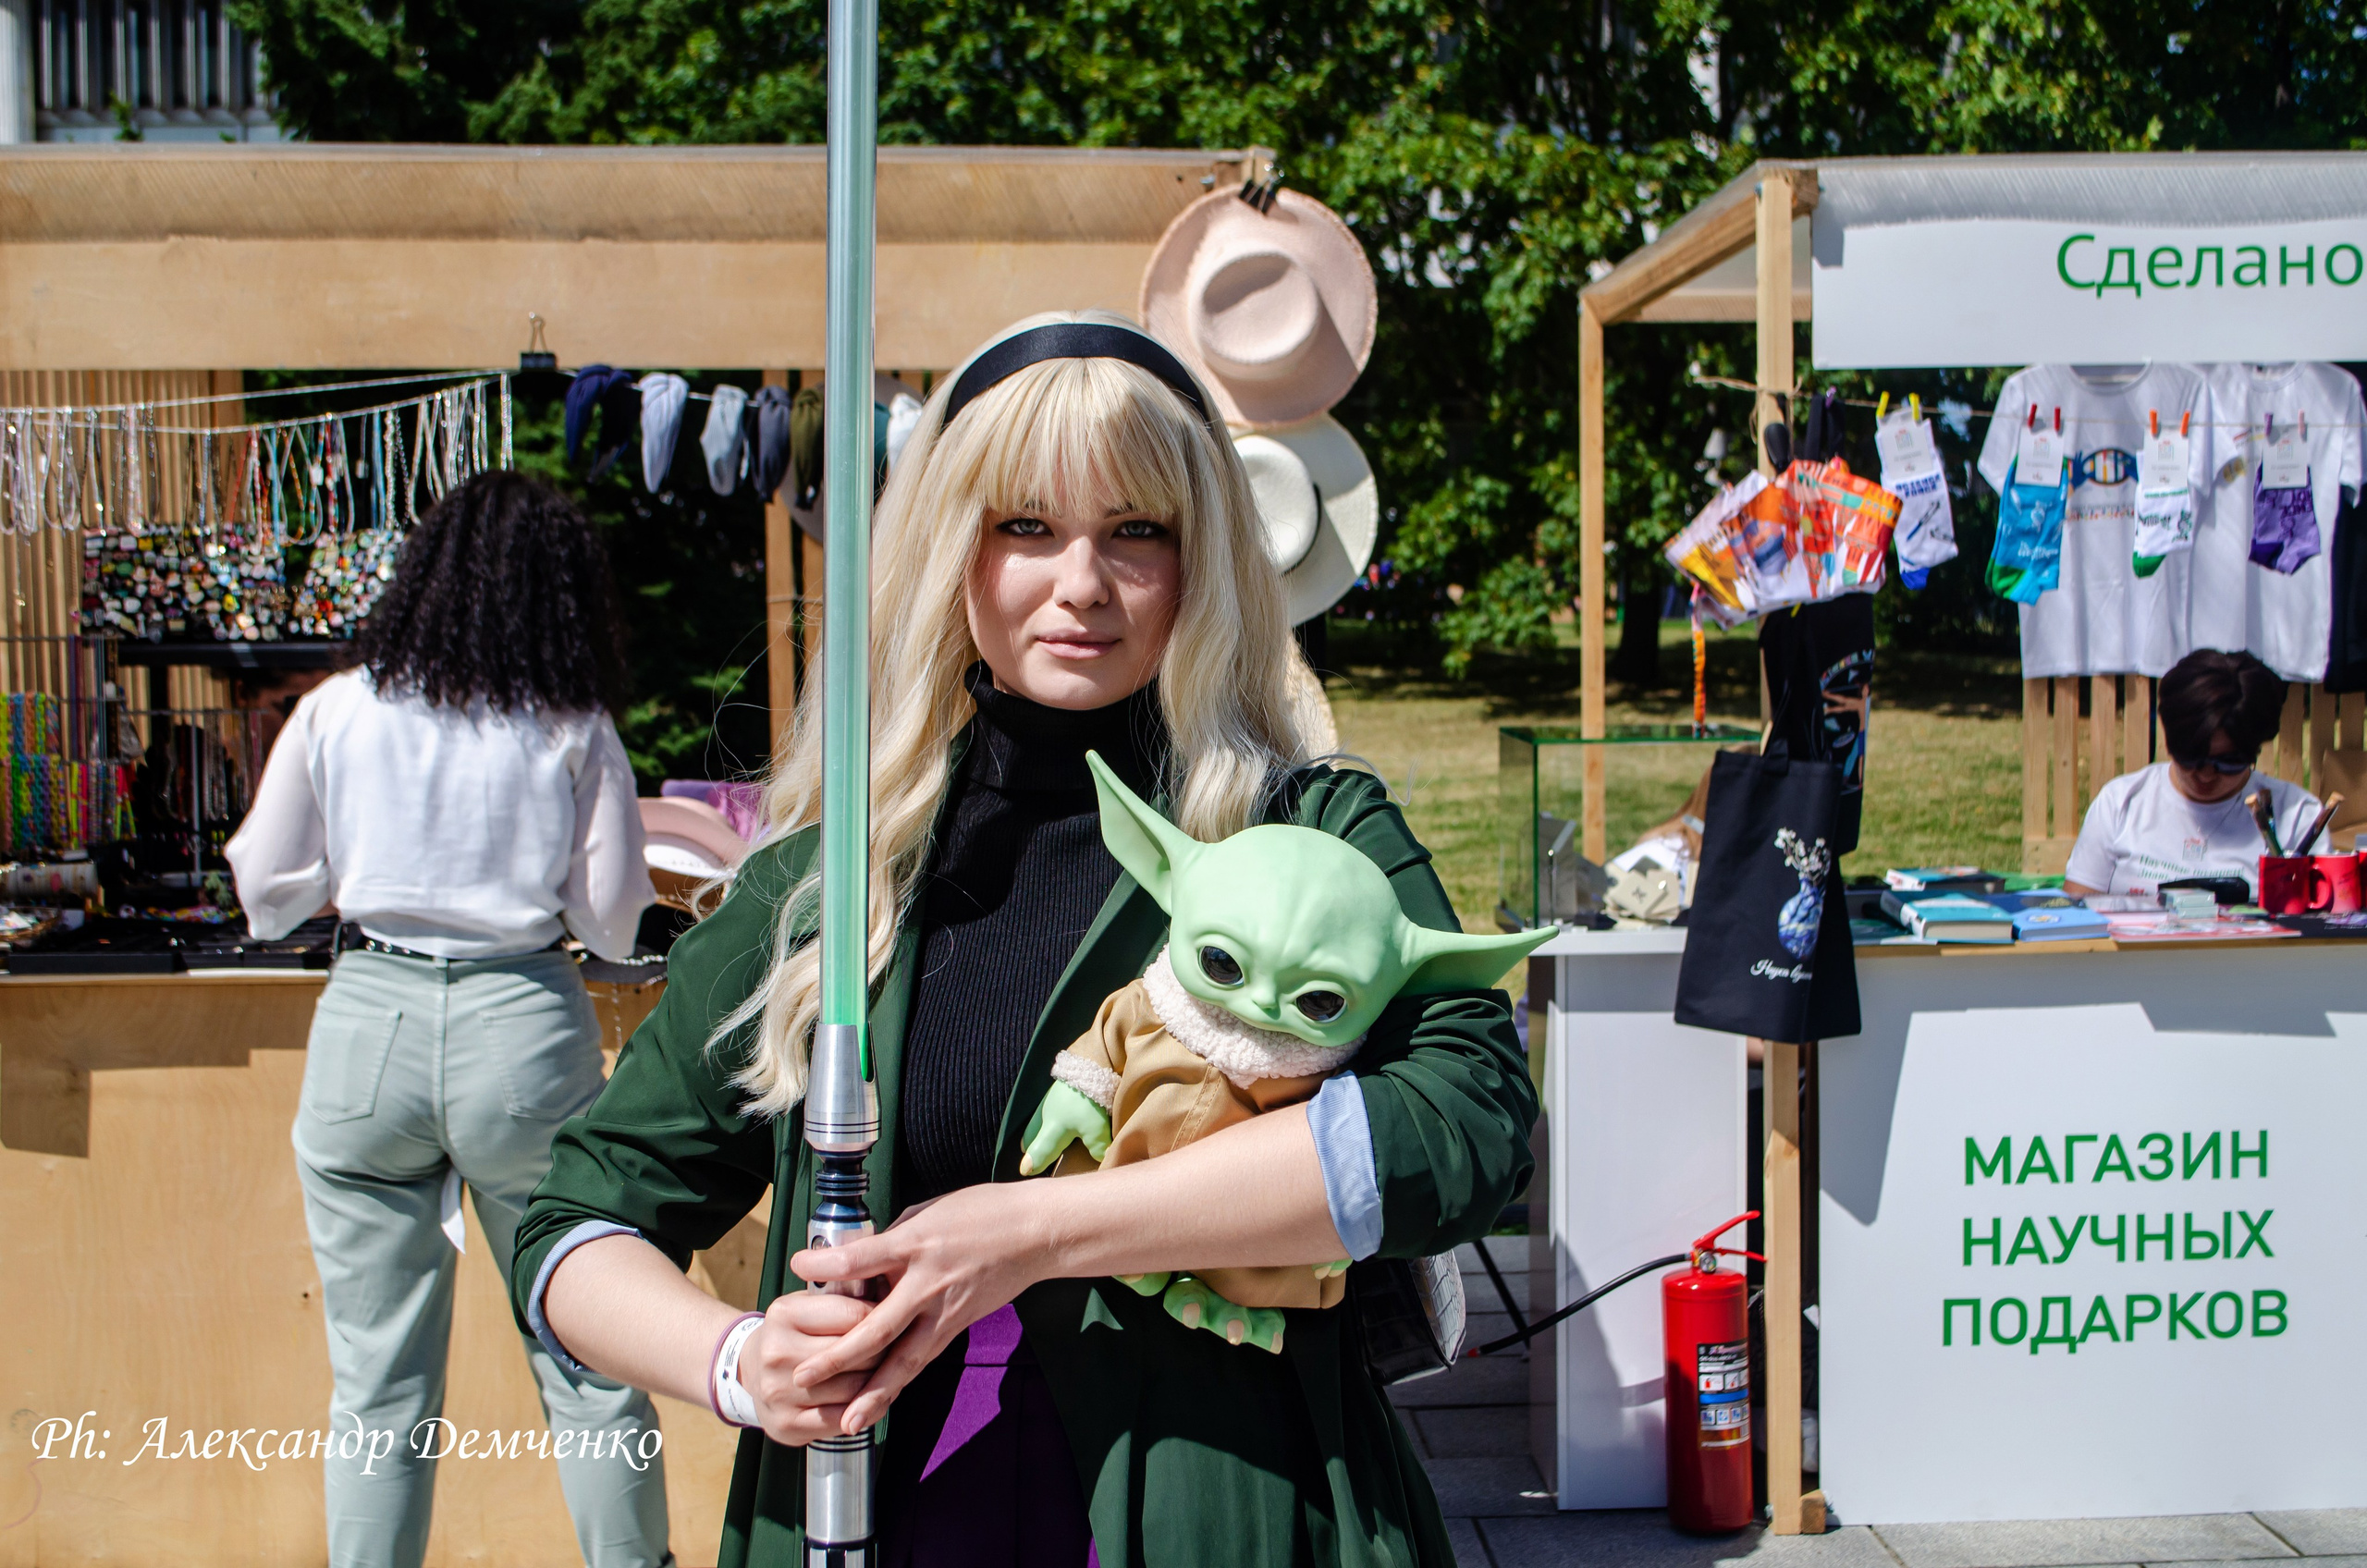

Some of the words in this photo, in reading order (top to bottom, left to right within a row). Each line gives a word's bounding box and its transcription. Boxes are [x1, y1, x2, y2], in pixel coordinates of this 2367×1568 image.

[2057, 233, 2364, 299] Сделано
[1964, 1129, 2270, 1187] МАГАЗИН
[1962, 1208, 2275, 1268] НАУЧНЫХ
[1943, 1288, 2289, 1356] ПОДАРКОВ
